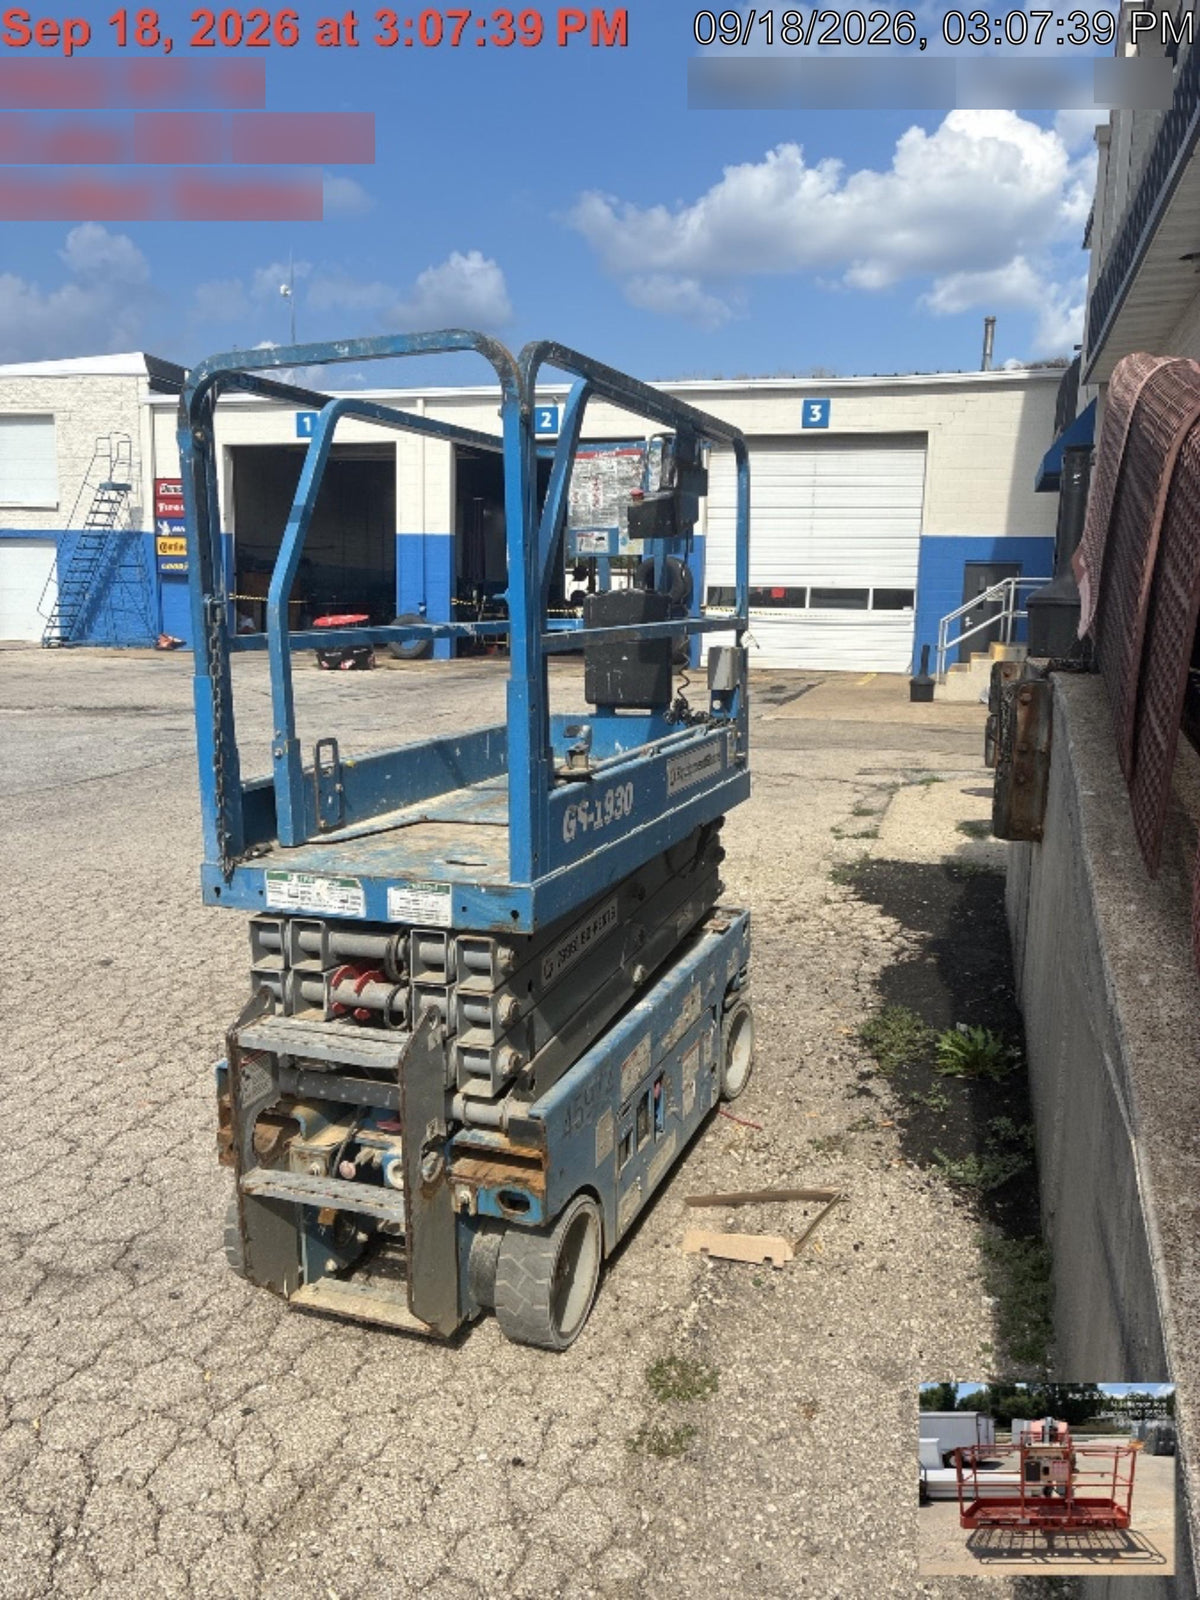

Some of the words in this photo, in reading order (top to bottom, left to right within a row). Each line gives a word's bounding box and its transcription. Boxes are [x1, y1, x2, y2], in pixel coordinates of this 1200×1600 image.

[541, 411, 552, 428] 2
[809, 405, 822, 422] 3
[303, 416, 311, 433] 1
